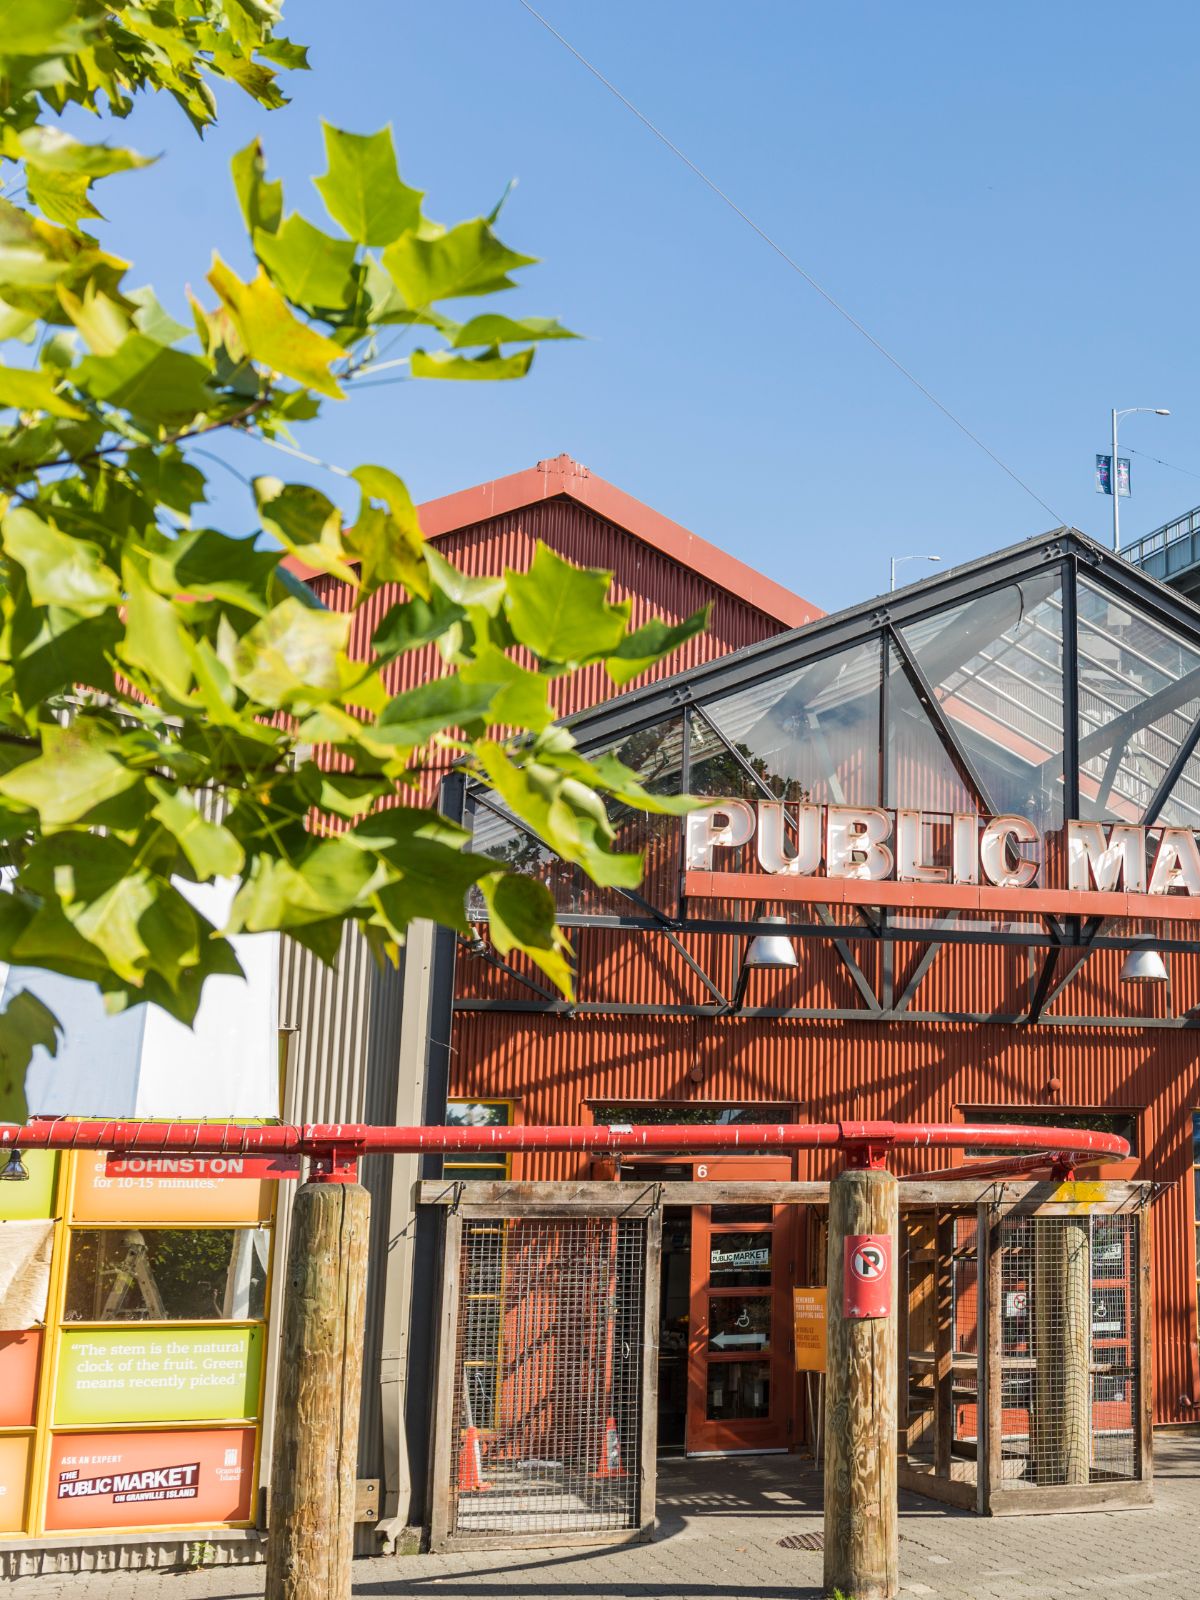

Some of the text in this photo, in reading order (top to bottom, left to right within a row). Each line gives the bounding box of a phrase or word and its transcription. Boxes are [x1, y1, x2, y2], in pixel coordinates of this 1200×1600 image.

[686, 797, 1042, 888] PUBLIC
[114, 1157, 244, 1173] JOHNSTON
[697, 1164, 708, 1178] 6
[93, 1177, 113, 1188] for
[117, 1177, 153, 1188] 10-15
[712, 1250, 767, 1262] PUBLIC MARKET
[110, 1345, 147, 1356] stem
[151, 1343, 162, 1355] is
[166, 1341, 190, 1355] the
[193, 1341, 245, 1354] natural
[76, 1358, 244, 1373] clock of the fruit. Green
[76, 1379, 125, 1390] means
[128, 1374, 186, 1391] recently
[61, 1455, 123, 1465] ASK AN EXPERT
[59, 1465, 197, 1497] PUBLIC MARKET
[60, 1470, 78, 1480] THE
[115, 1489, 196, 1503] ON GRANVILLE ISLAND
